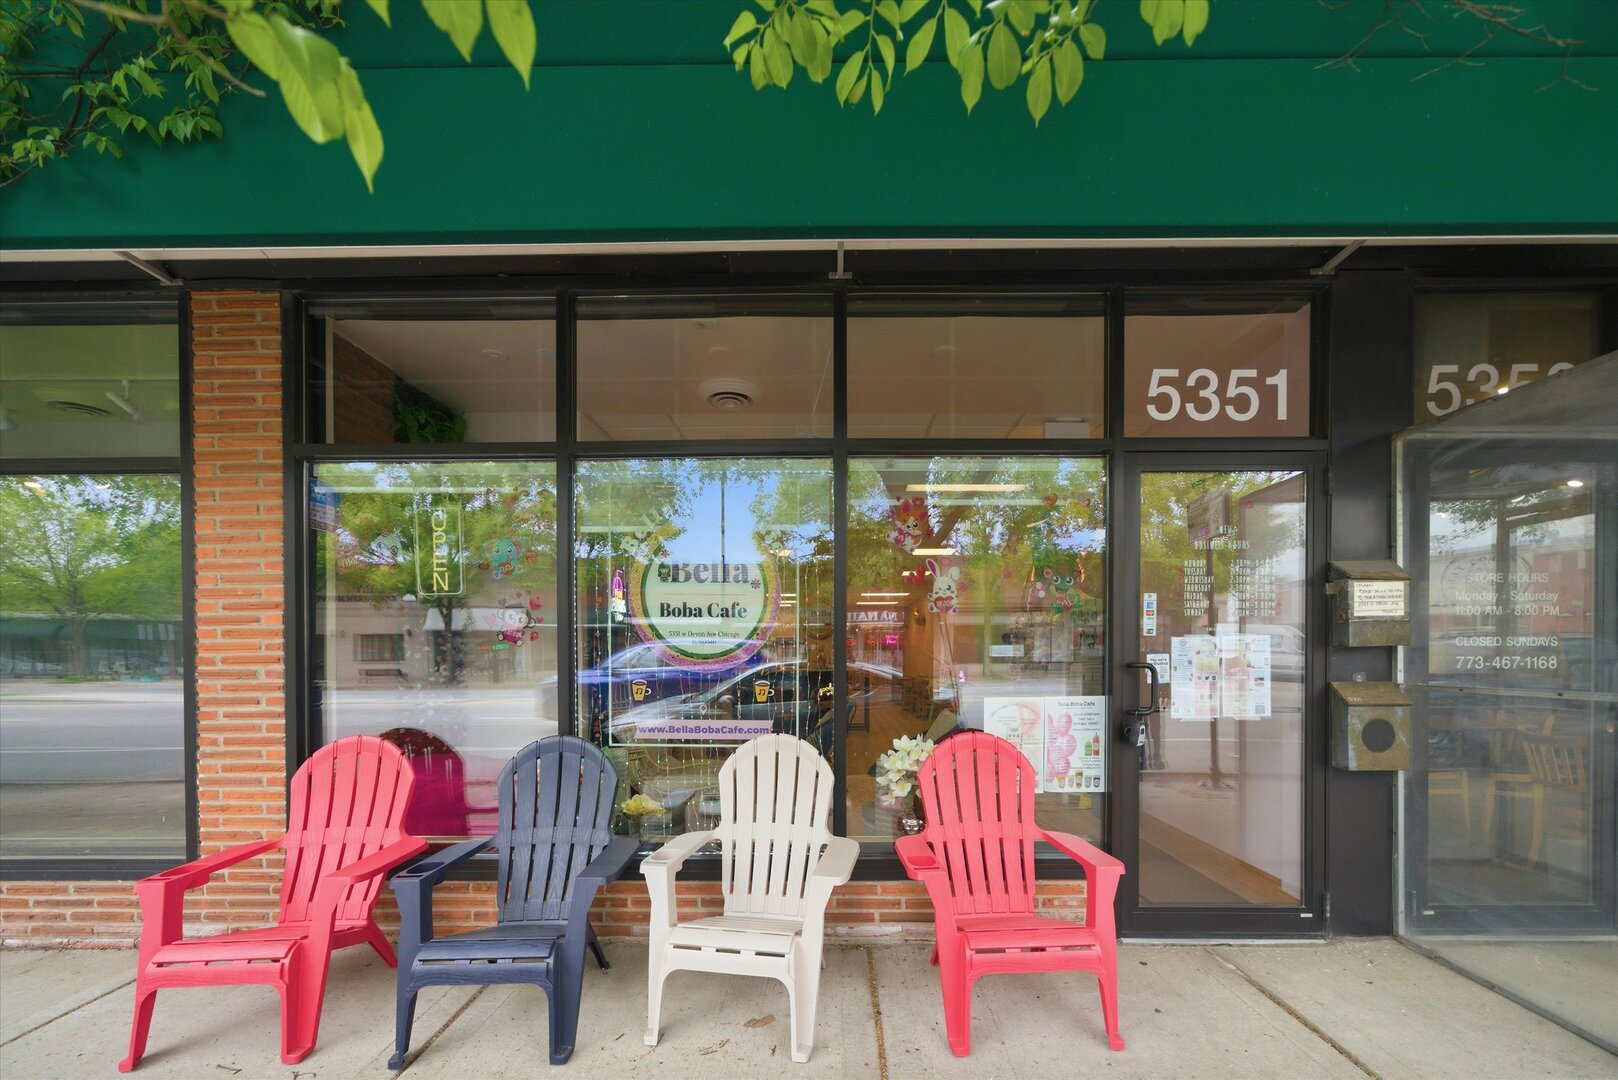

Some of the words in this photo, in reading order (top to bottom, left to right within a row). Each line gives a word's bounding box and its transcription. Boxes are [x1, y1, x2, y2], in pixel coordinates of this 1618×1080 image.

[1146, 368, 1288, 421] 5351
[1227, 540, 1250, 550] HOURS
[431, 511, 449, 591] OPEN
[1184, 559, 1206, 567] MONDAY
[670, 563, 750, 584] Bella
[1184, 568, 1206, 576] TUESDAY
[1466, 572, 1504, 582] STORE
[1509, 572, 1549, 582] HOURS
[1184, 576, 1214, 584] WEDNESDAY
[1184, 584, 1211, 592] THURSDAY
[1183, 592, 1203, 600] FRIDAY
[1455, 591, 1498, 602] Monday
[1510, 591, 1559, 602] Saturday
[1184, 600, 1210, 608] SATURDAY
[660, 602, 702, 618] Boba
[707, 602, 748, 618] Cafe
[1184, 608, 1204, 616] SUNDAY
[1456, 606, 1481, 616] 11:00
[1484, 606, 1503, 616] AM
[1514, 606, 1539, 616] 8:00
[1542, 606, 1560, 616] PM
[718, 630, 740, 638] Chicago
[1456, 636, 1502, 647] CLOSED
[1506, 636, 1558, 647] SUNDAYS
[1456, 656, 1558, 669] 773-467-1168
[638, 726, 770, 734] www.BellaBobaCafe.com
